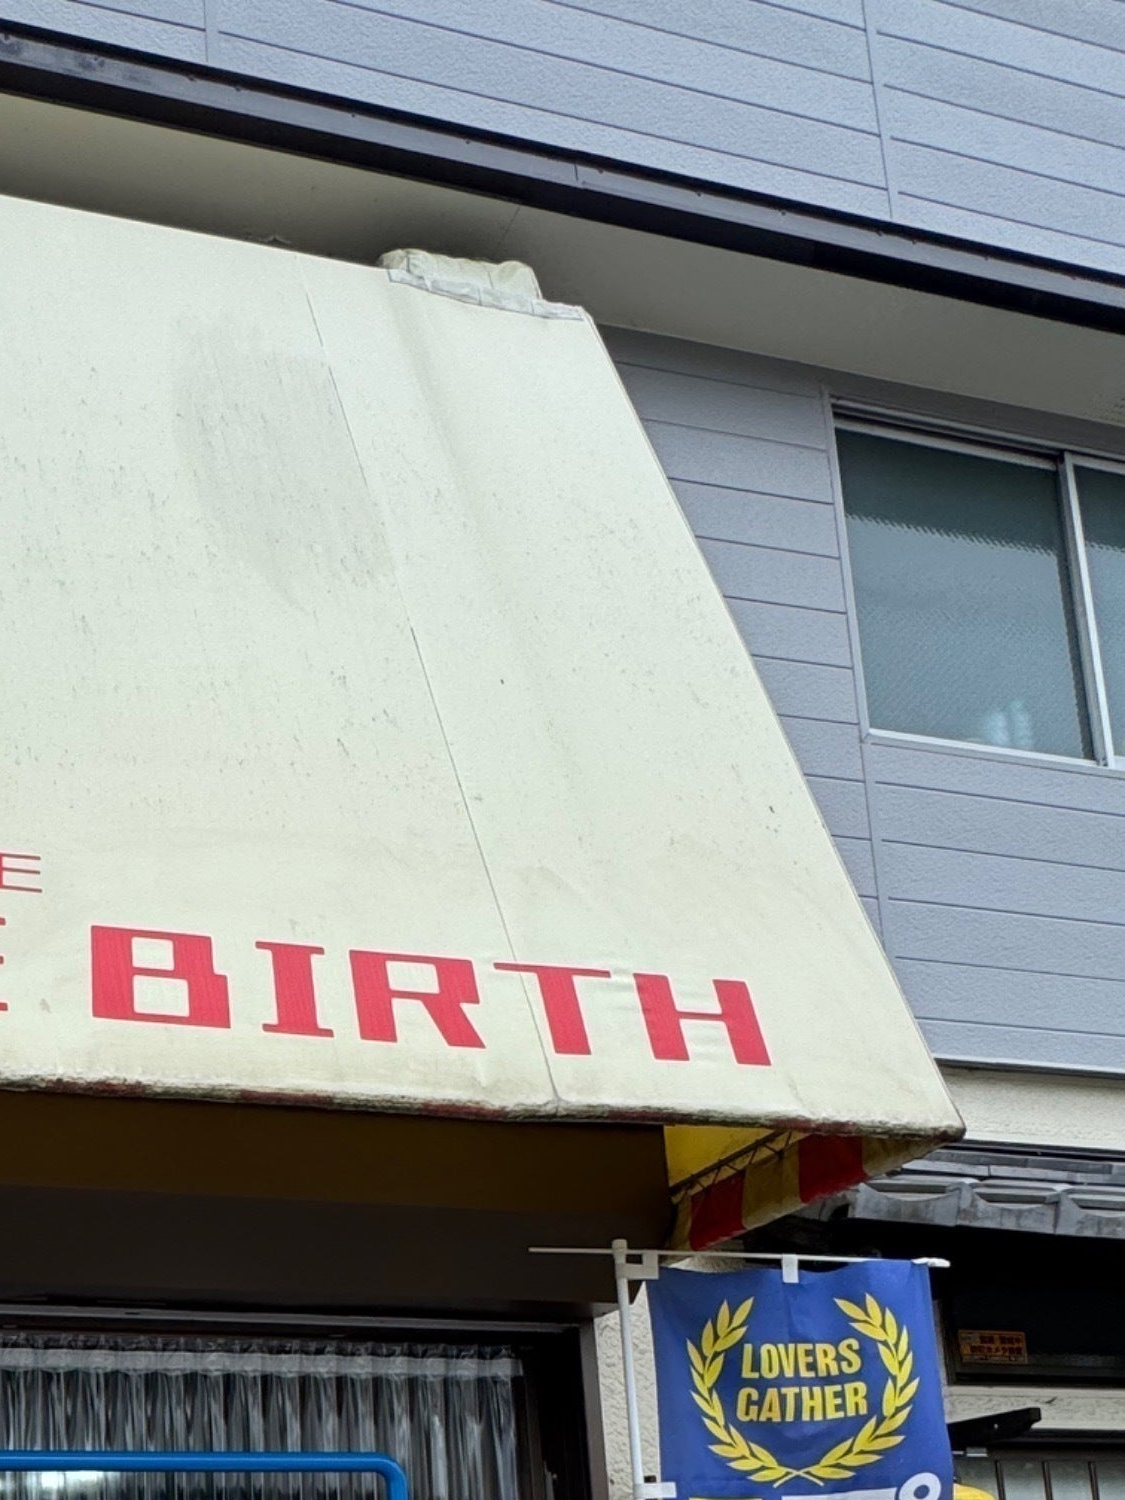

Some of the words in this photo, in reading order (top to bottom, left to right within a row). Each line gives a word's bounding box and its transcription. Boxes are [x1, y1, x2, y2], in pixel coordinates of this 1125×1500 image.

[90, 925, 772, 1067] BIRTH
[741, 1337, 863, 1380] LOVERS
[736, 1381, 868, 1423] GATHER
